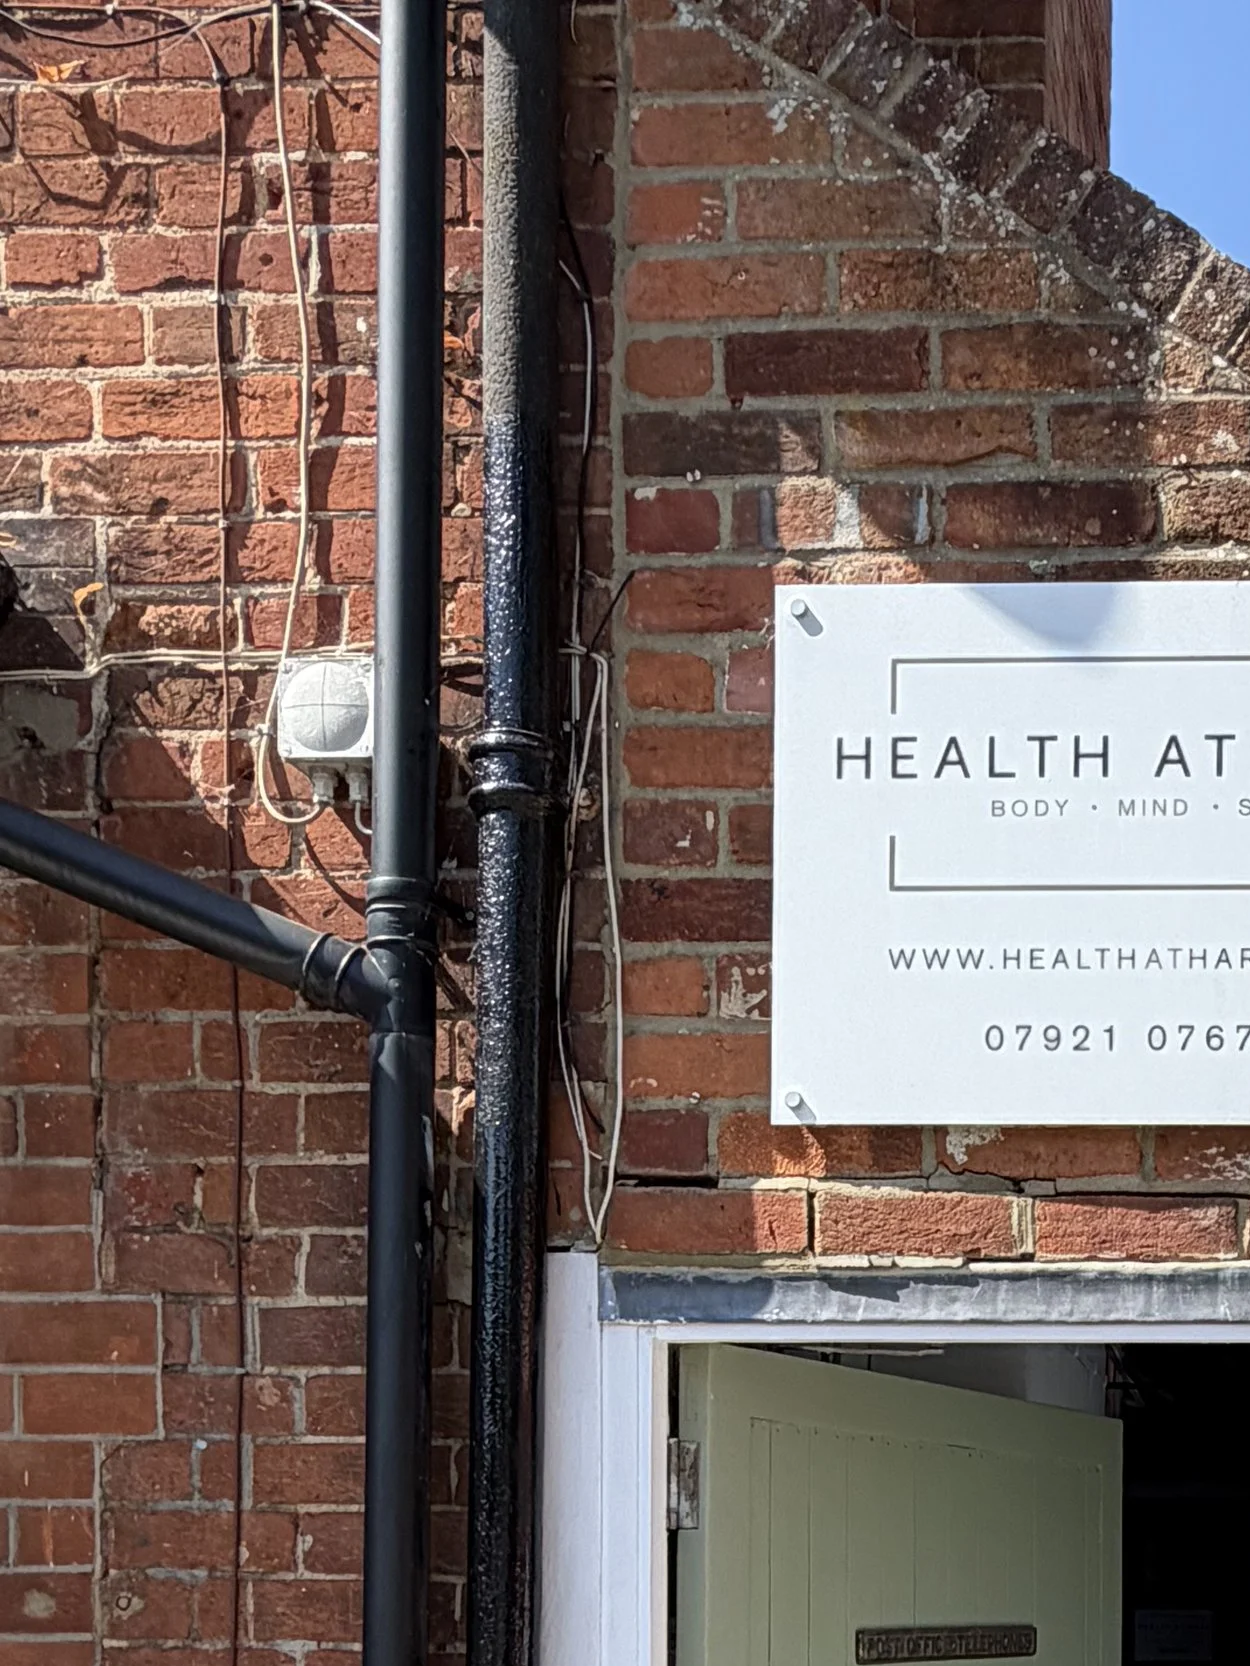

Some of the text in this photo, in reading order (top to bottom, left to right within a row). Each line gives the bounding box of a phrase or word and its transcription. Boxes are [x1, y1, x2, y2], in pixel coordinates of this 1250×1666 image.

[834, 735, 1112, 780] HEALTH
[1154, 733, 1238, 779] AT
[989, 798, 1070, 818] BODY
[1117, 798, 1189, 817] MIND
[984, 1025, 1119, 1053] 07921
